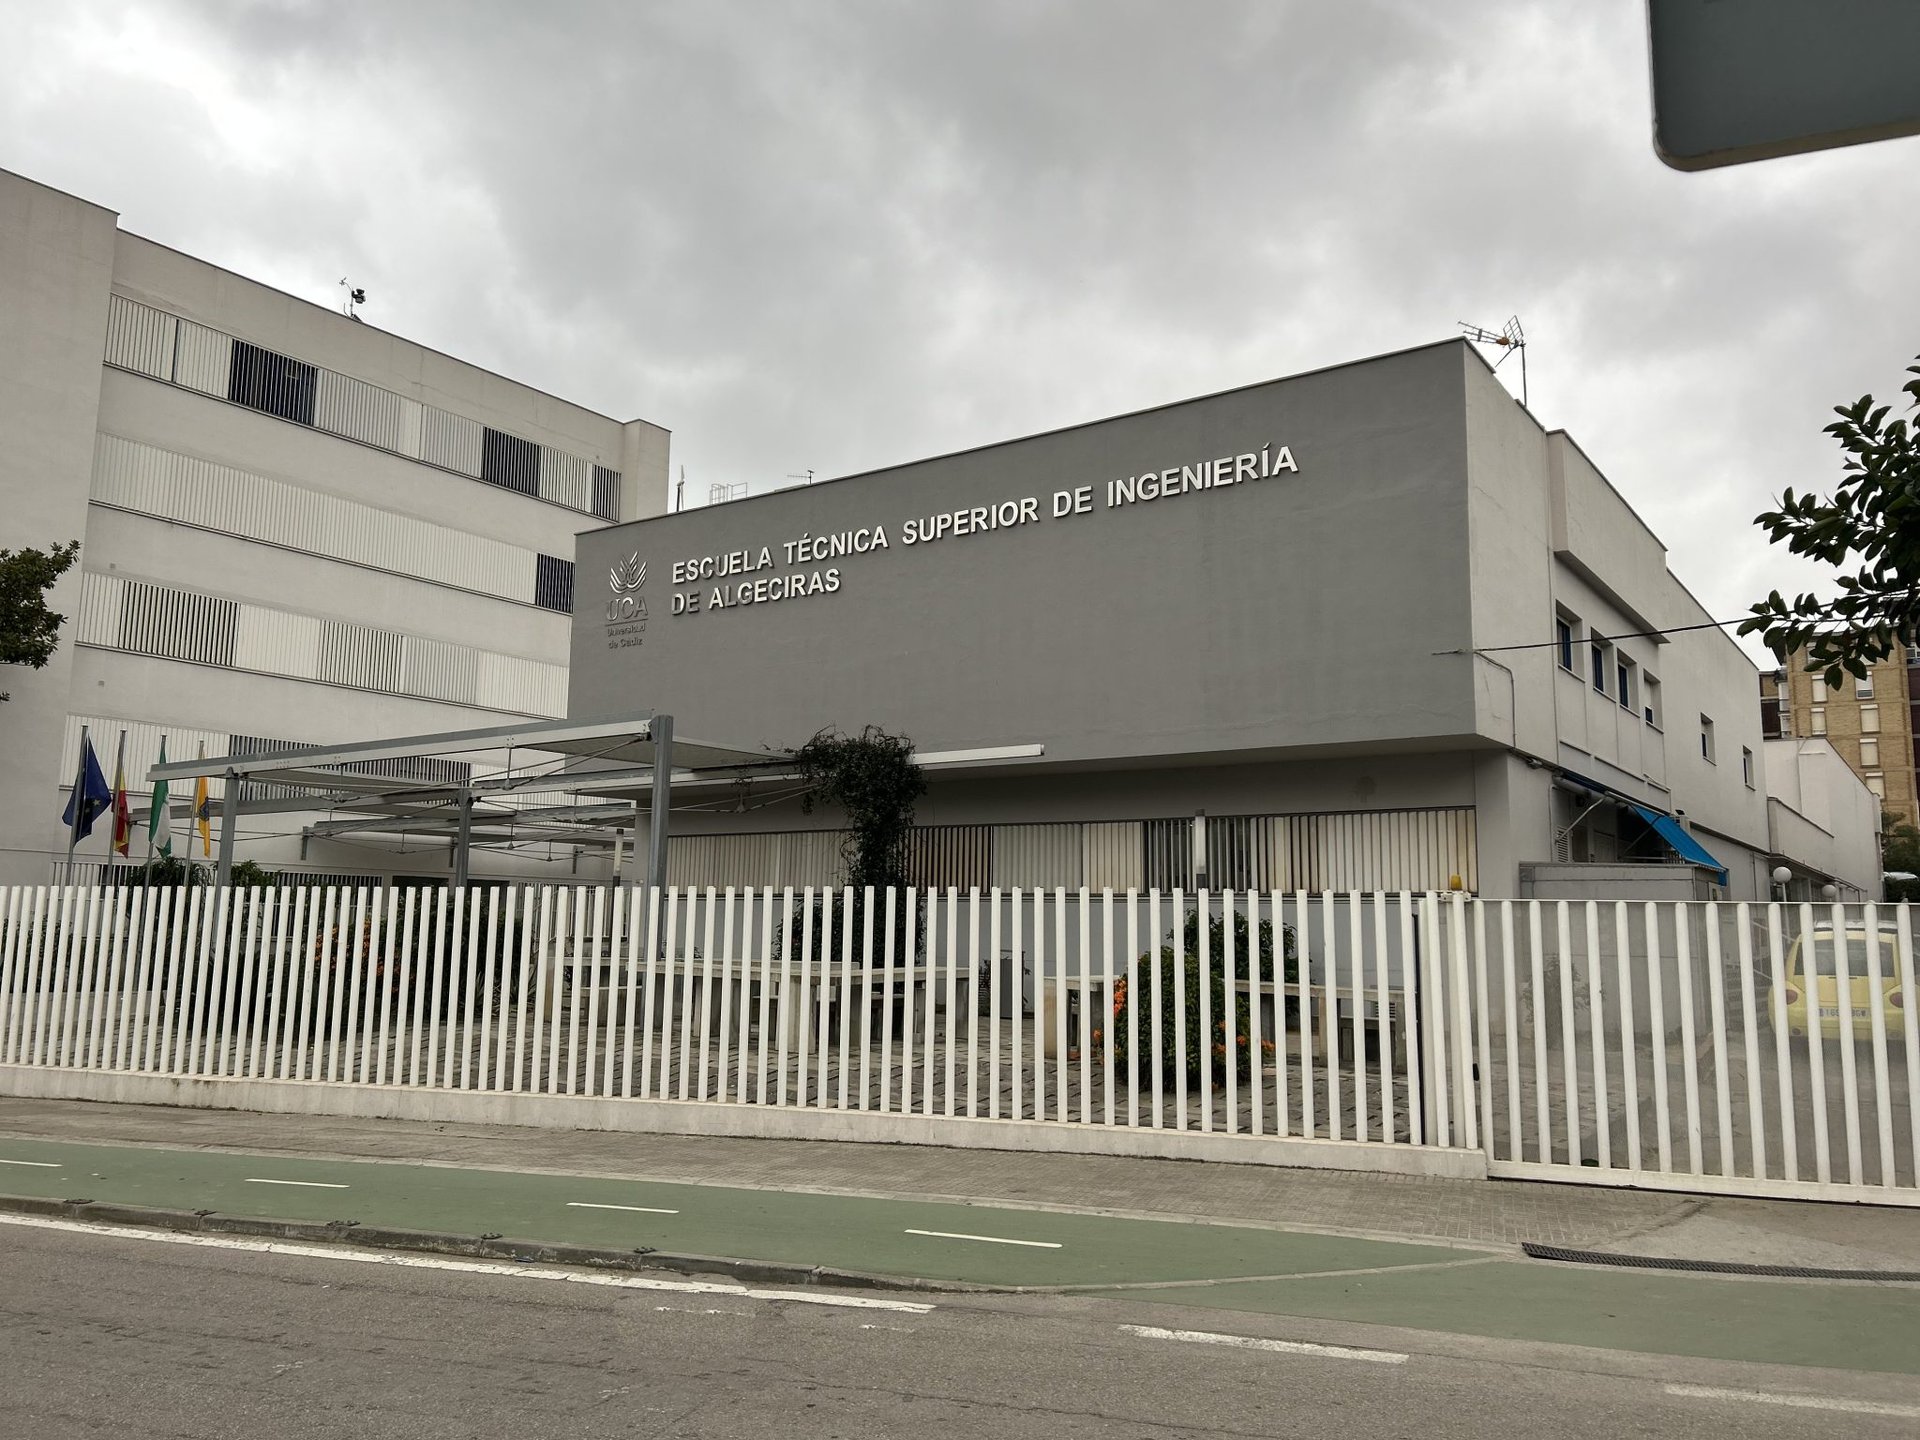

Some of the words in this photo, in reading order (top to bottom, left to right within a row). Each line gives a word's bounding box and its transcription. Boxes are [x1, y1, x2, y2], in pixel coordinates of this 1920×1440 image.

[672, 546, 775, 584] ESCUELA
[783, 525, 889, 564] TÉCNICA
[902, 497, 1039, 546] SUPERIOR
[1052, 485, 1093, 519] DE
[1107, 442, 1299, 508] INGENIERÍA
[606, 596, 648, 621] UCA
[671, 590, 700, 616] DE
[708, 568, 841, 610] ALGECIRAS
